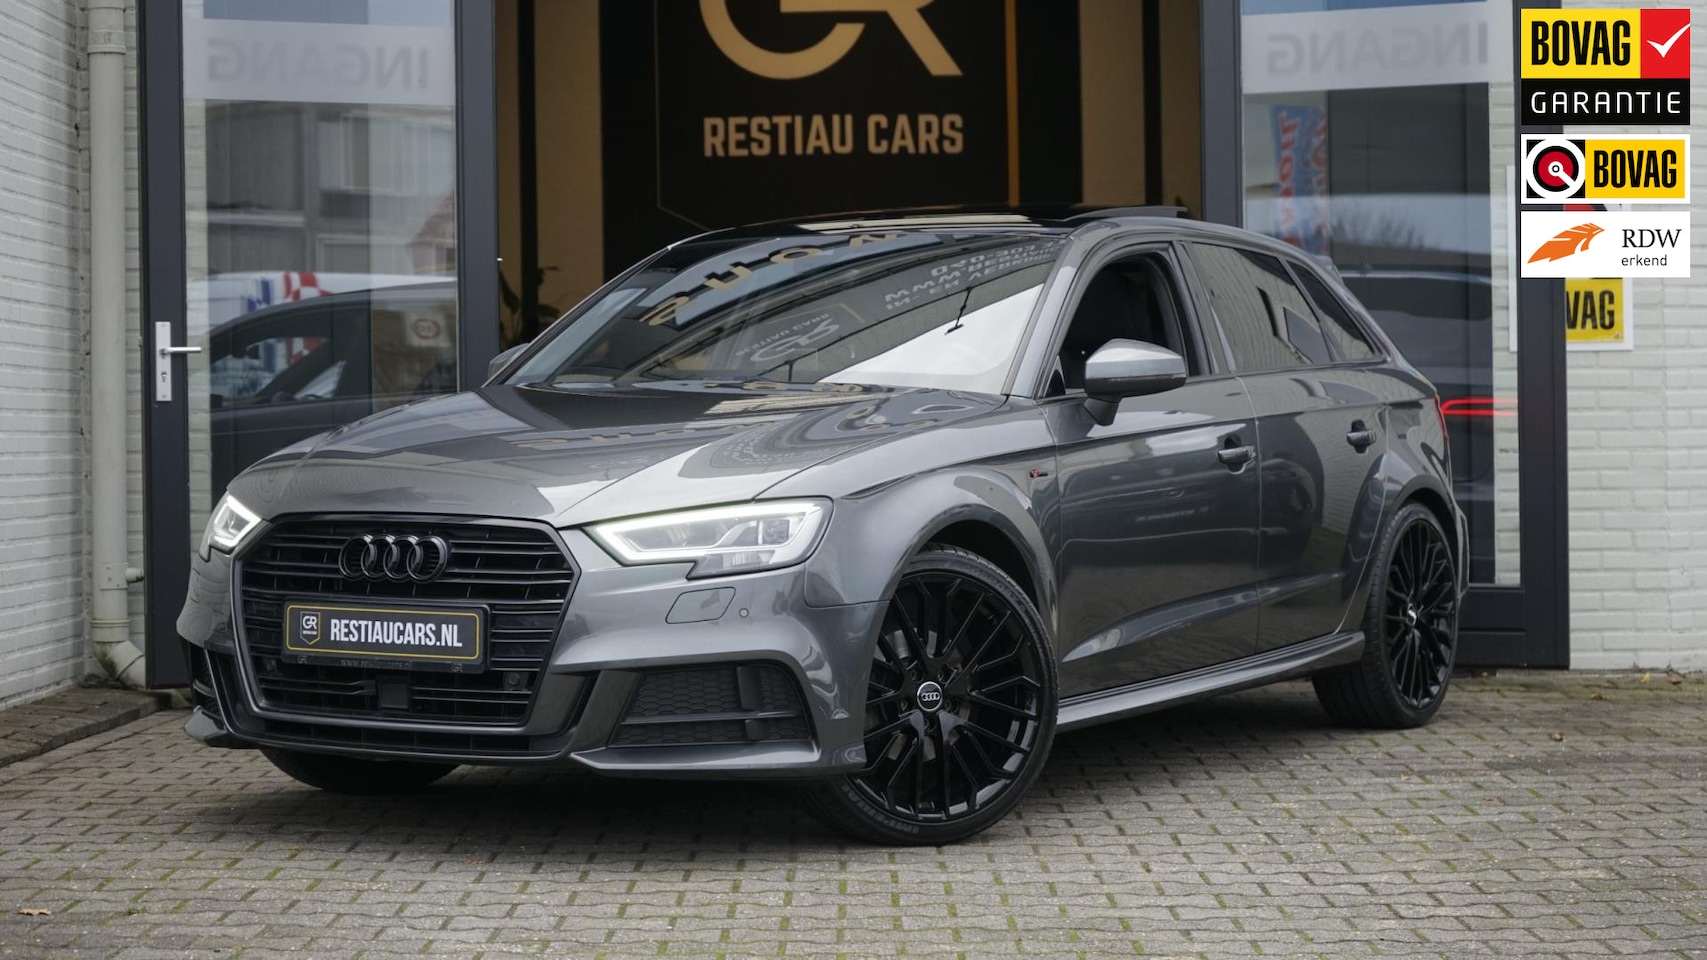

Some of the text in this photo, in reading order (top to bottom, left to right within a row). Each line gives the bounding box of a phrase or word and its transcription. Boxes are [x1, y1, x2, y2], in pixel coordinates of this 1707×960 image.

[703, 113, 964, 157] RESTIAU CARS
[1565, 290, 1615, 330] VAG
[329, 618, 463, 648] RESTIAUCARS.NL
